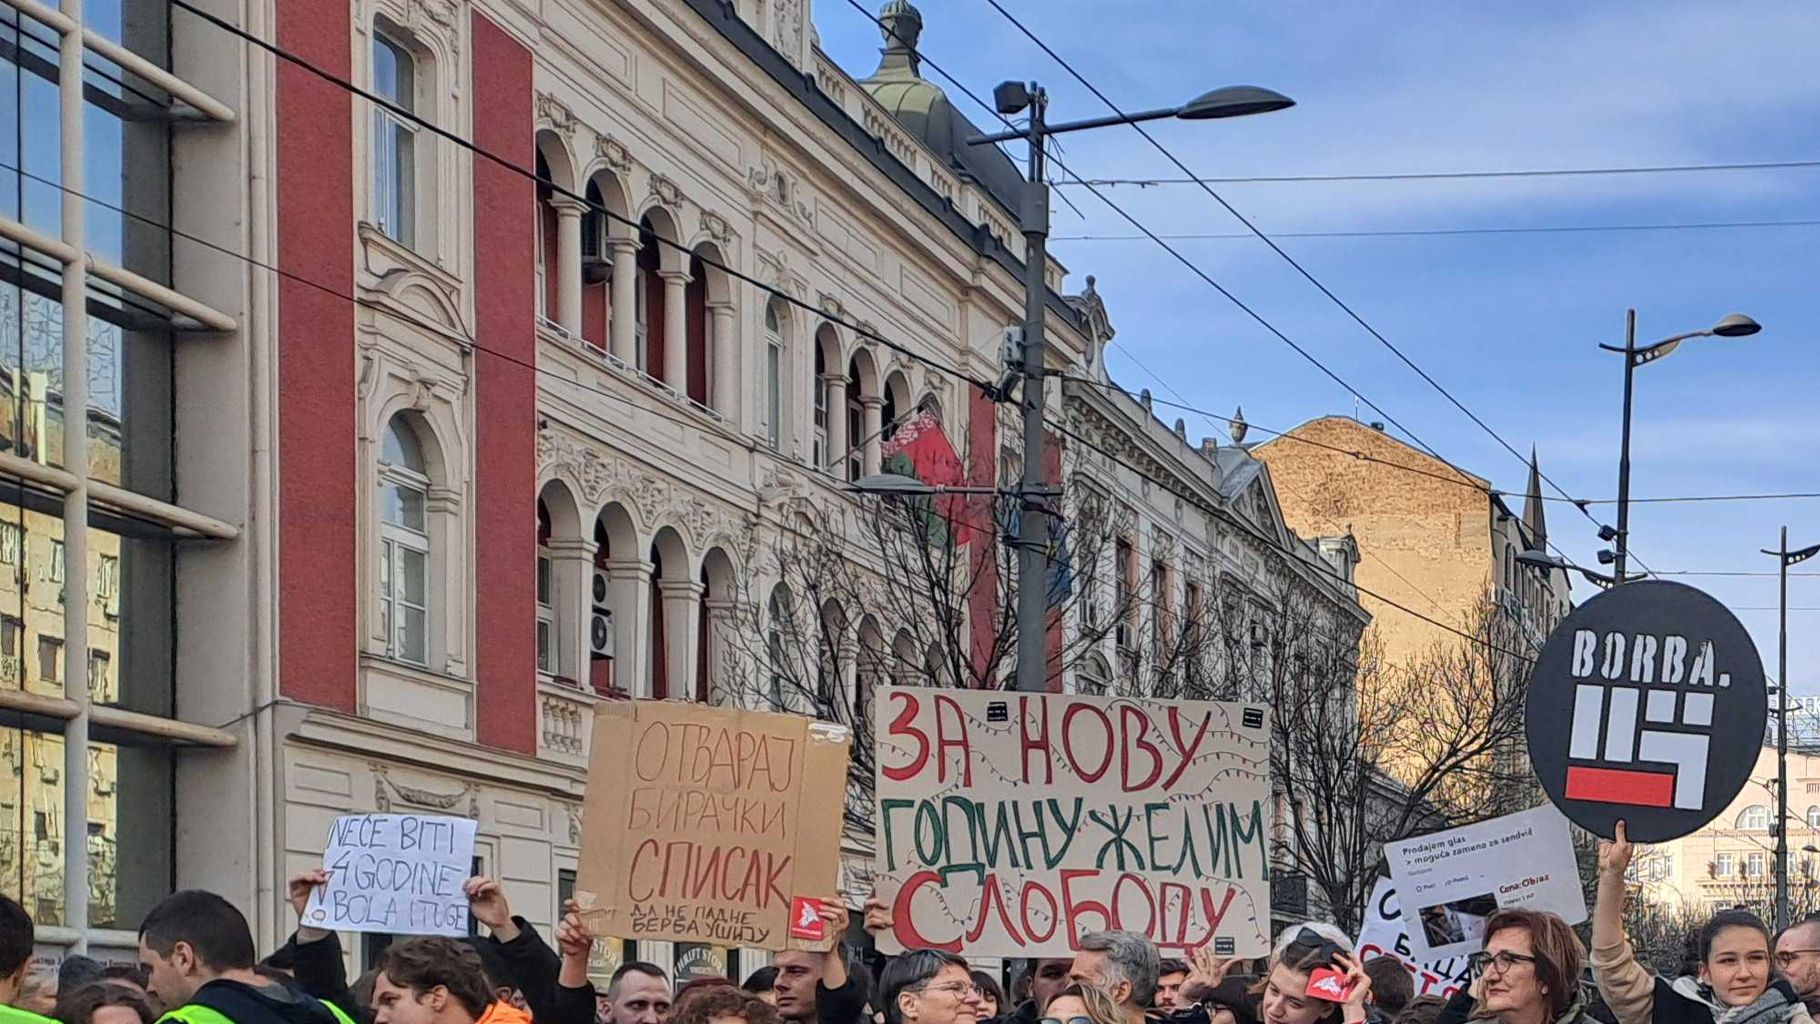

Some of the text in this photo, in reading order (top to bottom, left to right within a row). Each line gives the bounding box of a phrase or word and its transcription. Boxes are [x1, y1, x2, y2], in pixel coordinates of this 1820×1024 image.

[1571, 628, 1732, 688] BORBA.
[635, 720, 796, 793] ОТВАРАЈ
[880, 691, 1212, 793] ЗА НОВУ
[400, 816, 455, 854] BITI
[627, 787, 787, 841] БИРАЧКИ
[880, 796, 1270, 889] ГОДИНУ ЖЕЛИМ
[1402, 836, 1467, 856] Prodajem glas
[354, 853, 463, 897] GODINE
[629, 837, 793, 910] СПИСАК
[333, 889, 398, 926] BOLA
[630, 904, 757, 926] ДА НЕ ПАДНЕ
[631, 917, 700, 935] БЕРБА
[891, 868, 1237, 958] СЛОБОДУ
